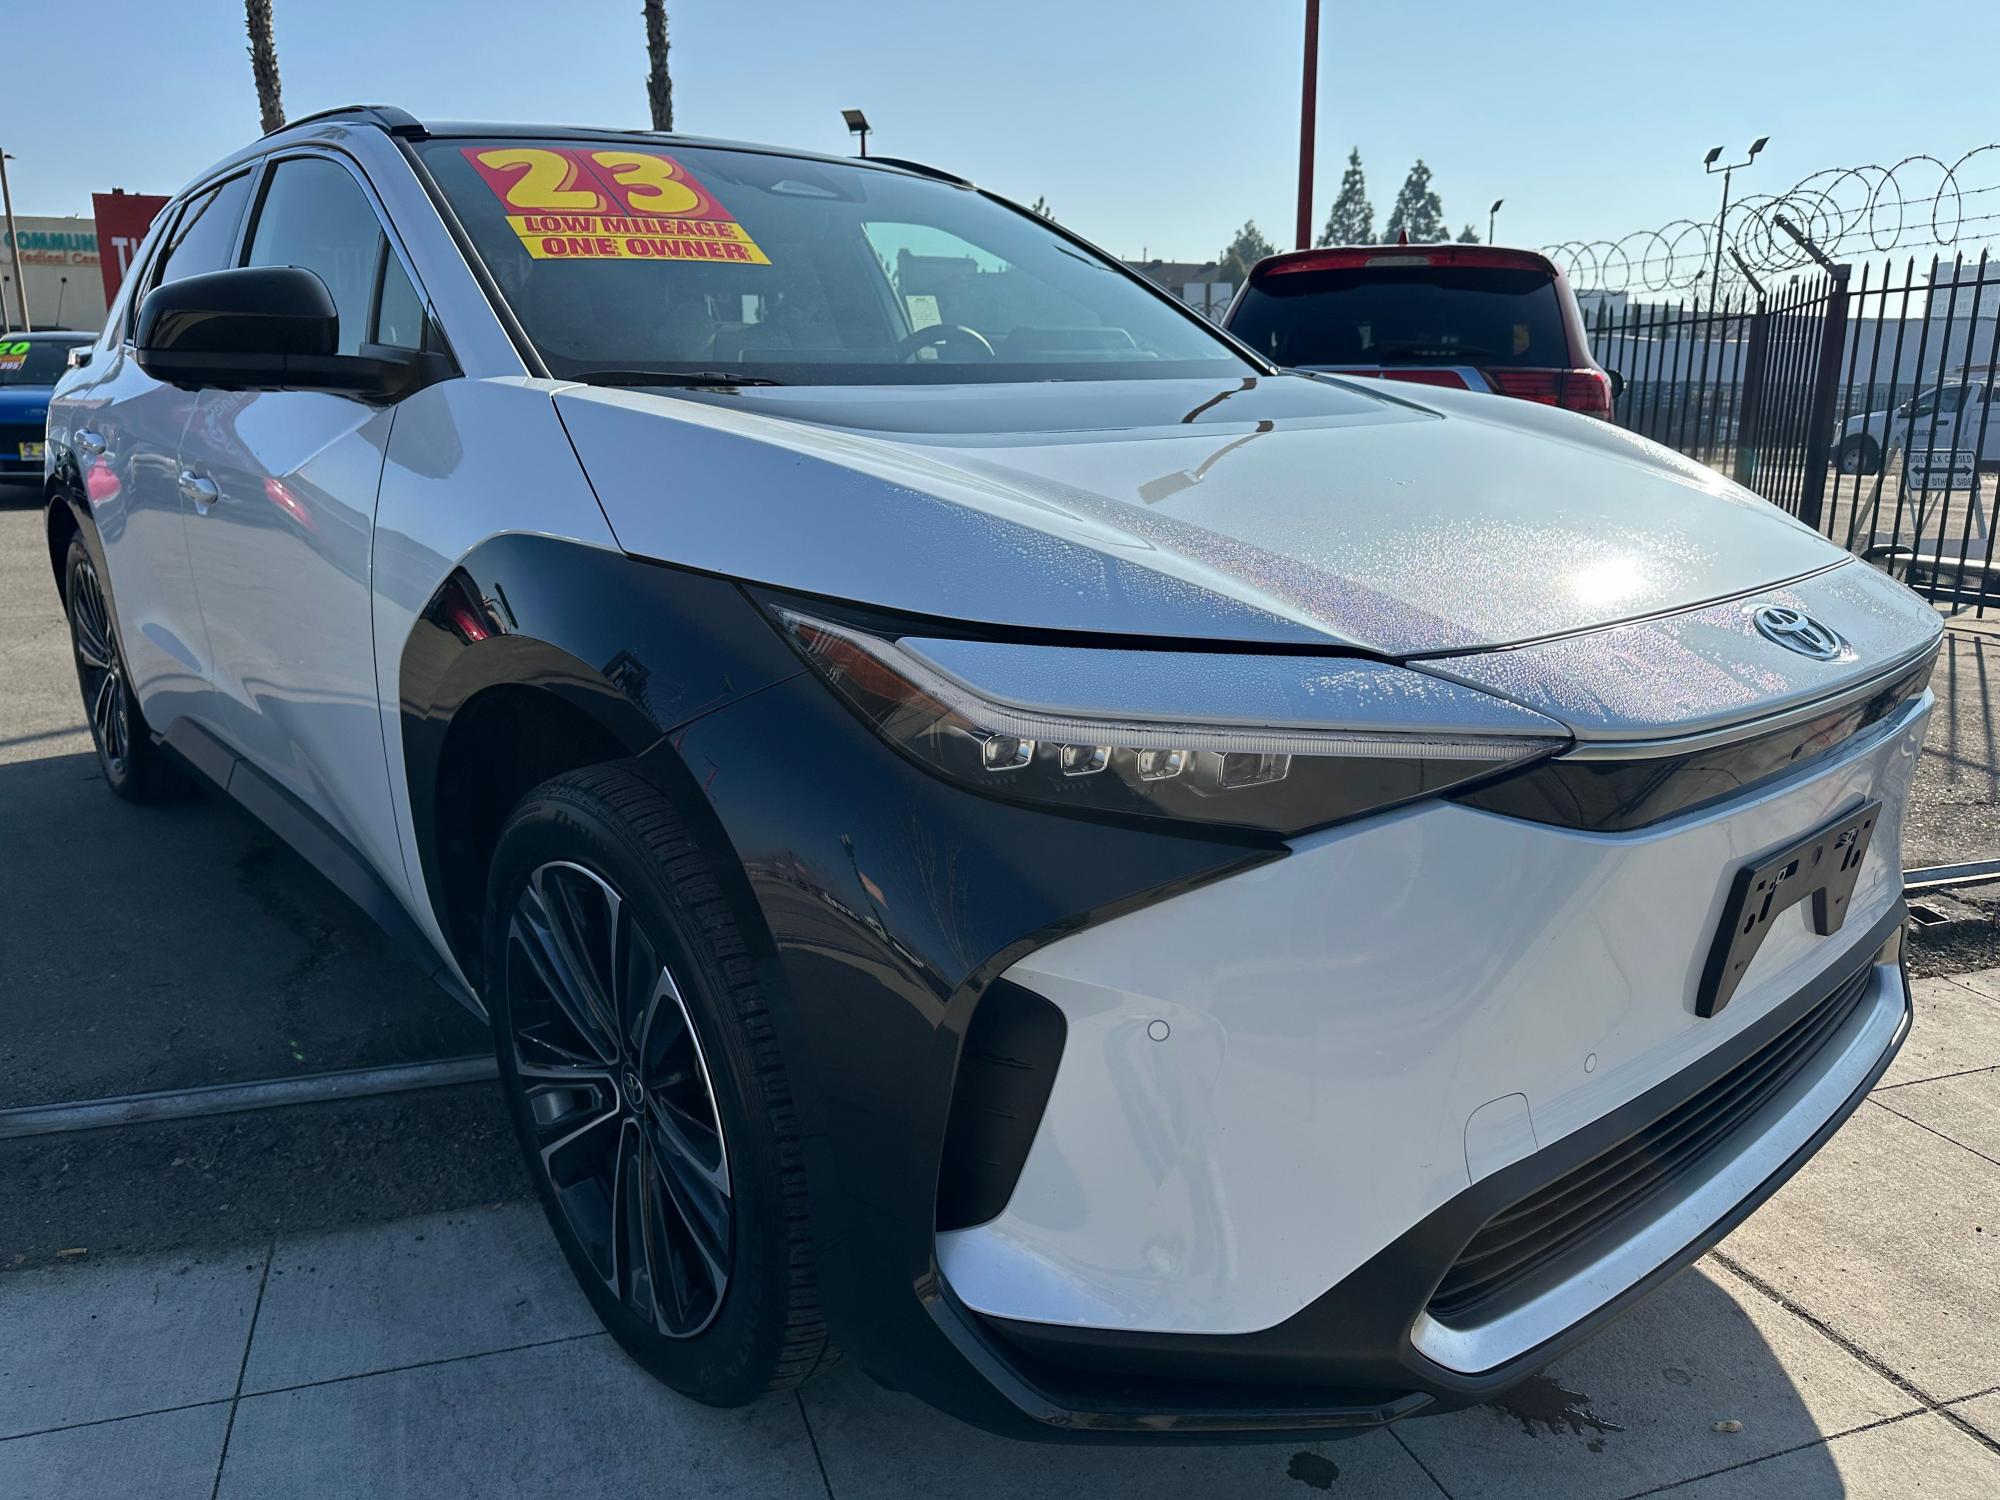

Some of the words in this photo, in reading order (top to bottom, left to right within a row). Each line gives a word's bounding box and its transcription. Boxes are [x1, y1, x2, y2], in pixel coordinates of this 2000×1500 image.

[476, 148, 703, 214] 23
[524, 216, 597, 234] LOW
[601, 218, 738, 239] MILEAGE
[541, 237, 620, 257] ONE
[625, 239, 752, 261] OWNER
[1909, 455, 1943, 464] SIDELK
[1944, 455, 1972, 464] CSED
